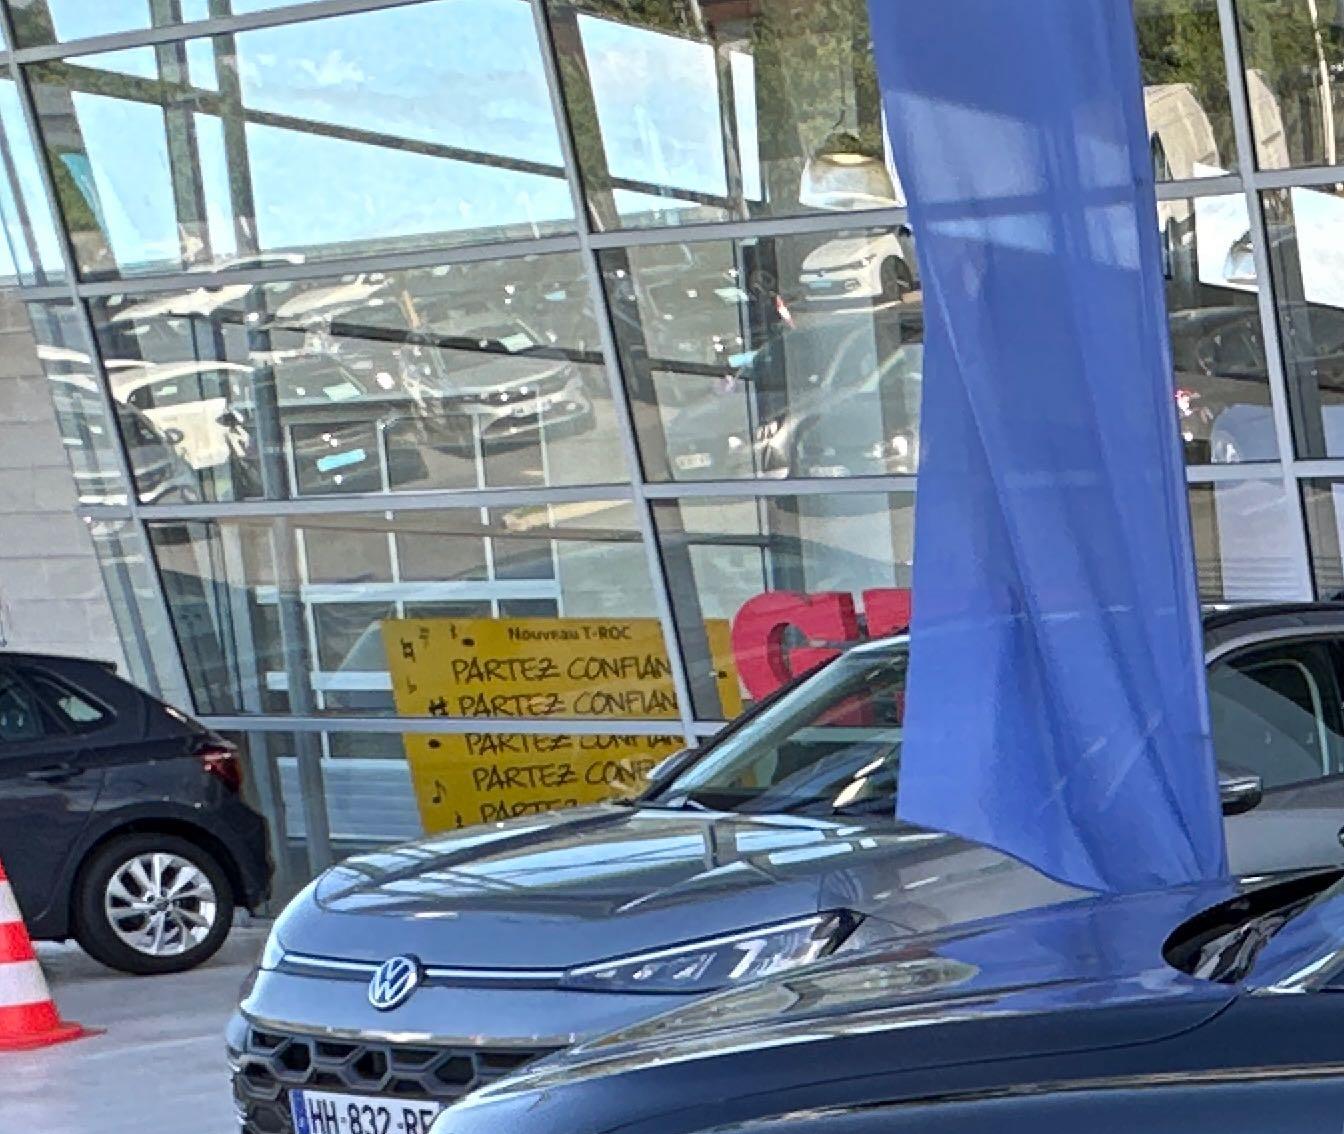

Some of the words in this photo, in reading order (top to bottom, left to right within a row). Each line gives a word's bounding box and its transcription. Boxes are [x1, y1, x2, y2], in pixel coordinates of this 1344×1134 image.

[508, 627, 579, 641] Nouveau
[582, 625, 631, 640] T-ROC
[451, 656, 560, 684] PARTEZ
[566, 654, 671, 681] CONFIAN
[458, 691, 566, 717] PARTEZ
[573, 690, 678, 715] CONFIAN
[472, 762, 577, 791] PARTEZ
[369, 956, 417, 1009] VW
